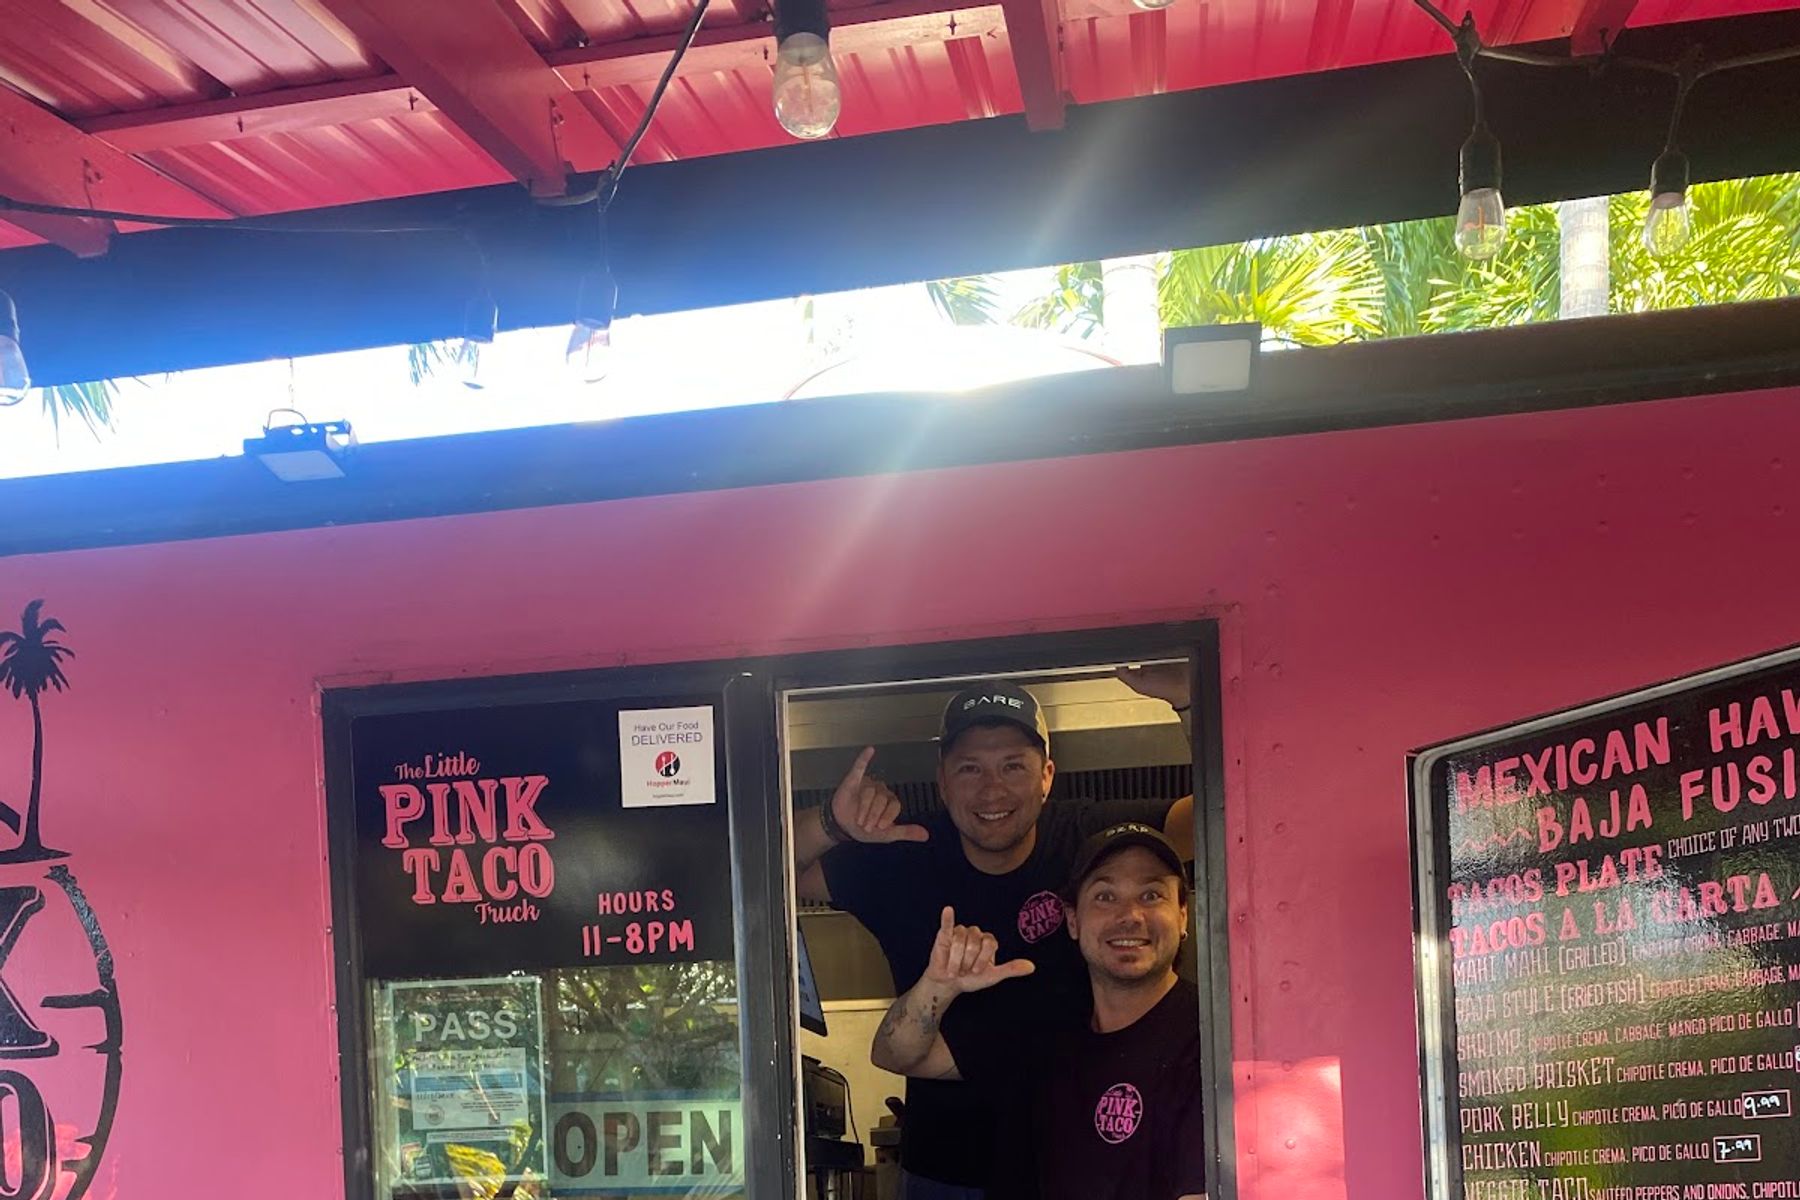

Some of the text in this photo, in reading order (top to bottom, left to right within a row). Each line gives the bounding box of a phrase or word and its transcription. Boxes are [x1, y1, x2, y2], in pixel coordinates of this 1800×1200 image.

[632, 732, 702, 746] DELIVERED
[634, 721, 698, 732] Have Our Food
[395, 751, 480, 781] The Little
[1456, 717, 1671, 814] MEXICAN
[378, 775, 555, 849] PINK
[1536, 784, 1652, 852] BAJA
[403, 842, 555, 904] TACO
[1448, 869, 1544, 916] TACOS
[1555, 845, 1662, 897] PLATE
[1668, 831, 1717, 859] CHOICE
[1720, 827, 1738, 849] OF
[1743, 822, 1769, 845] ANY
[474, 897, 540, 924] Truck
[598, 890, 676, 915] HOURS
[1019, 900, 1060, 929] PINK
[1450, 873, 1780, 958] TACOS A LA CARTA
[582, 920, 695, 957] 11-8PM
[1454, 955, 1499, 985] MAHI
[1505, 947, 1550, 978] MAHI
[409, 1011, 518, 1042] PASS
[1459, 1057, 1615, 1098] SMOKED BRISKET
[1100, 1097, 1138, 1118] PINK
[1460, 1104, 1505, 1134] PORK
[1512, 1100, 1570, 1130] BELLY
[1572, 1106, 1619, 1126] CHIPOTLE
[1690, 1100, 1704, 1118] DE
[1707, 1097, 1743, 1117] GALLO
[1745, 1095, 1780, 1117] 9.99
[1100, 1115, 1133, 1134] TACO
[554, 1110, 733, 1178] OPEN
[1462, 1141, 1541, 1171] CHICKEN
[1717, 1138, 1752, 1157] 7.99
[1683, 1183, 1705, 1200] AND
